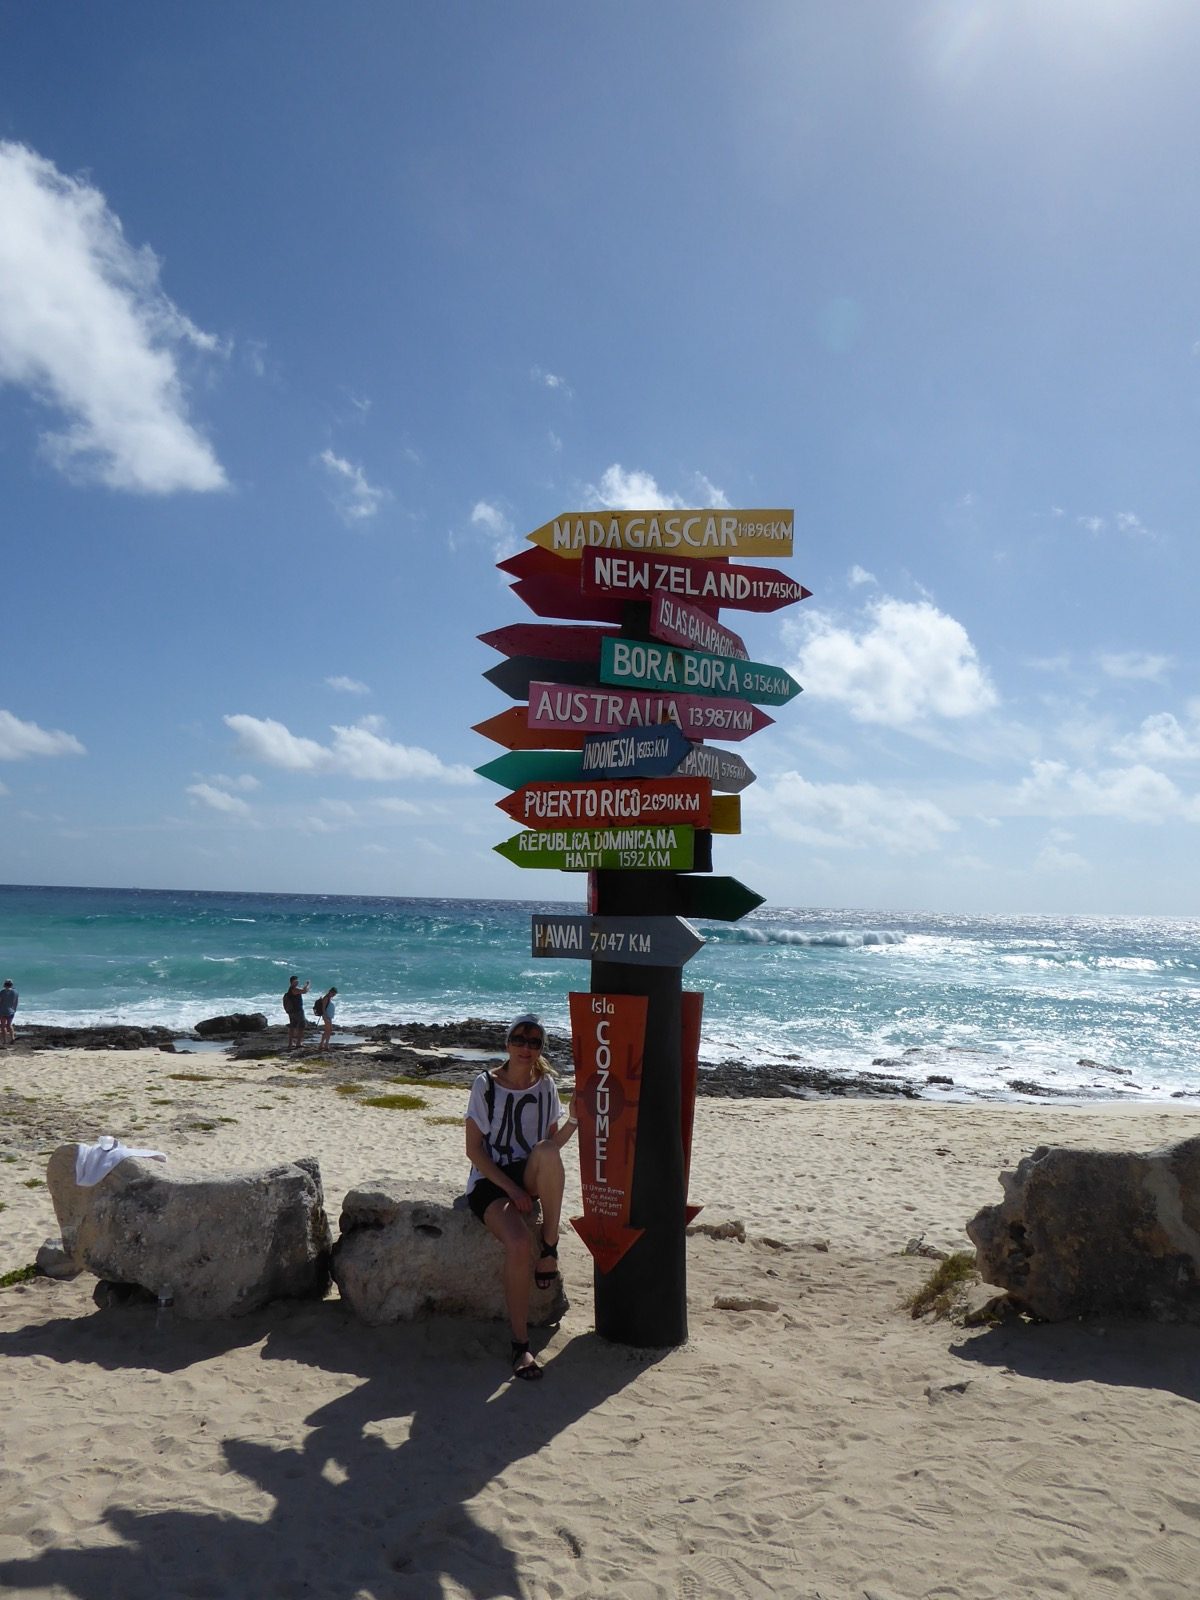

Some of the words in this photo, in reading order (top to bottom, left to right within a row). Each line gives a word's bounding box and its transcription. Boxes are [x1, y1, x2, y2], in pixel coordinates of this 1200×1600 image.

[553, 516, 738, 550] MADAGASCAR
[595, 557, 649, 589] NEW
[654, 564, 751, 599] ZELAND
[660, 598, 687, 635] ISLAS
[614, 643, 676, 683] BORA
[685, 656, 740, 693] BORA
[535, 690, 683, 730] AUSTRALIA
[583, 737, 635, 770] INDONESIA
[686, 750, 720, 780] PASCUA
[524, 790, 597, 818] PUERTO
[601, 788, 641, 817] RICO
[594, 829, 678, 851] DOMINICANA
[629, 934, 651, 953] KM
[591, 997, 615, 1014] Isla
[595, 1021, 611, 1182] COZUMEL
